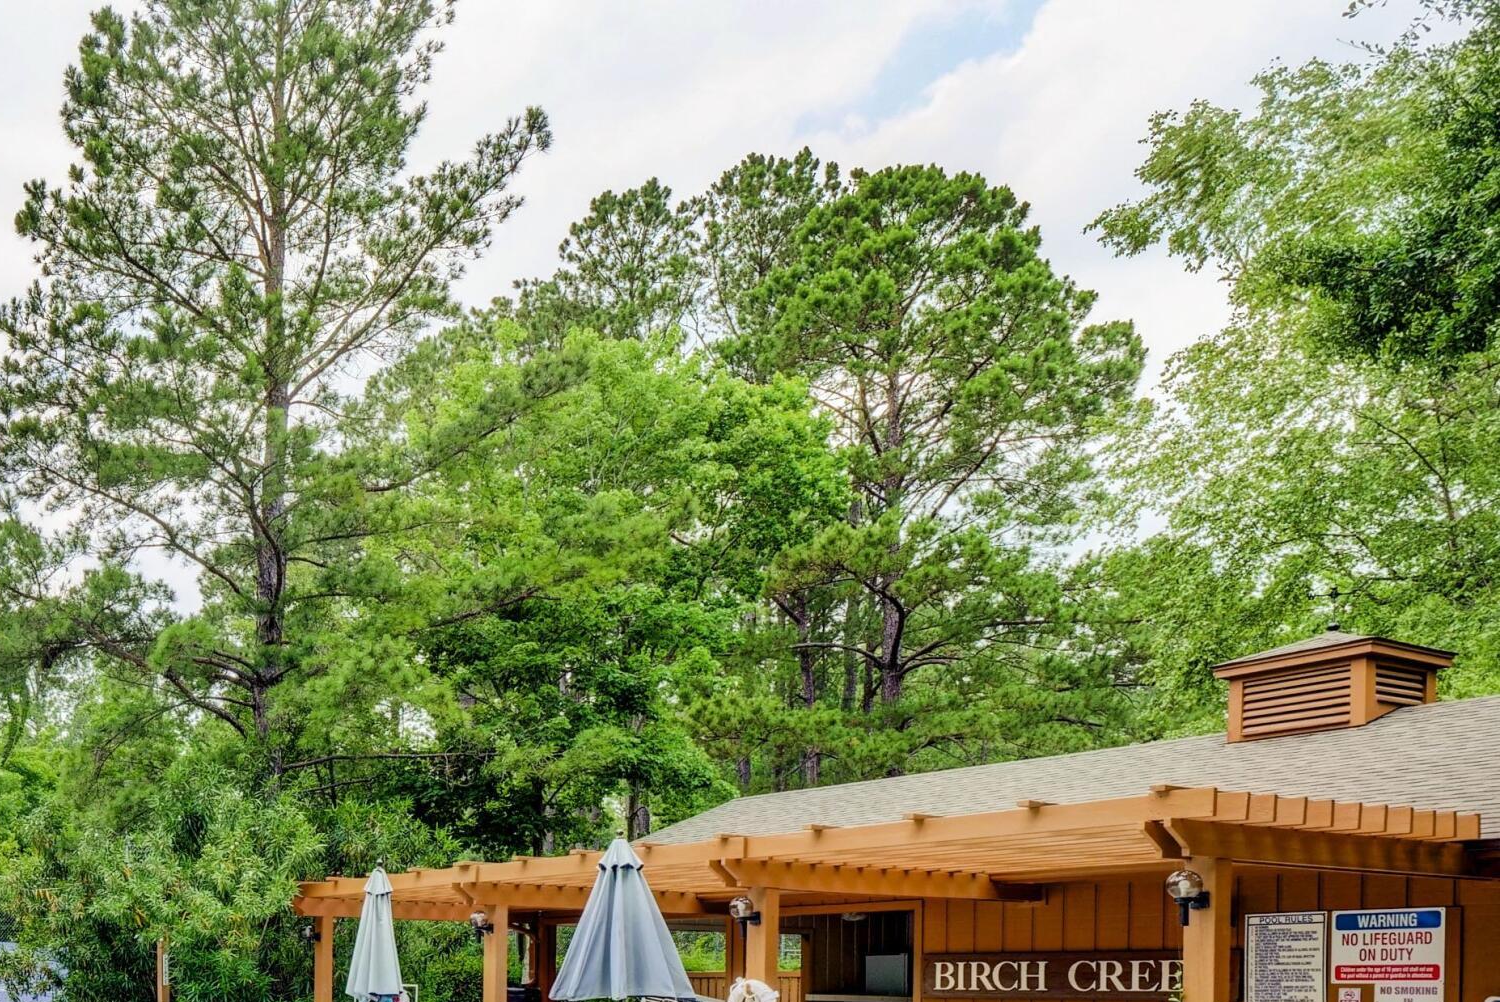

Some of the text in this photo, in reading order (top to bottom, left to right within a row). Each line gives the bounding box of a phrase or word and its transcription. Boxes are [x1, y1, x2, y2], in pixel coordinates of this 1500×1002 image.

[1259, 914, 1314, 925] POOL RULES
[1357, 912, 1418, 928] WARNING
[1341, 931, 1433, 946] NO LIFEGUARD
[1359, 947, 1414, 962] ON DUTY
[933, 959, 1185, 992] BIRCH CREE
[1380, 986, 1438, 995] NO SMOKING
